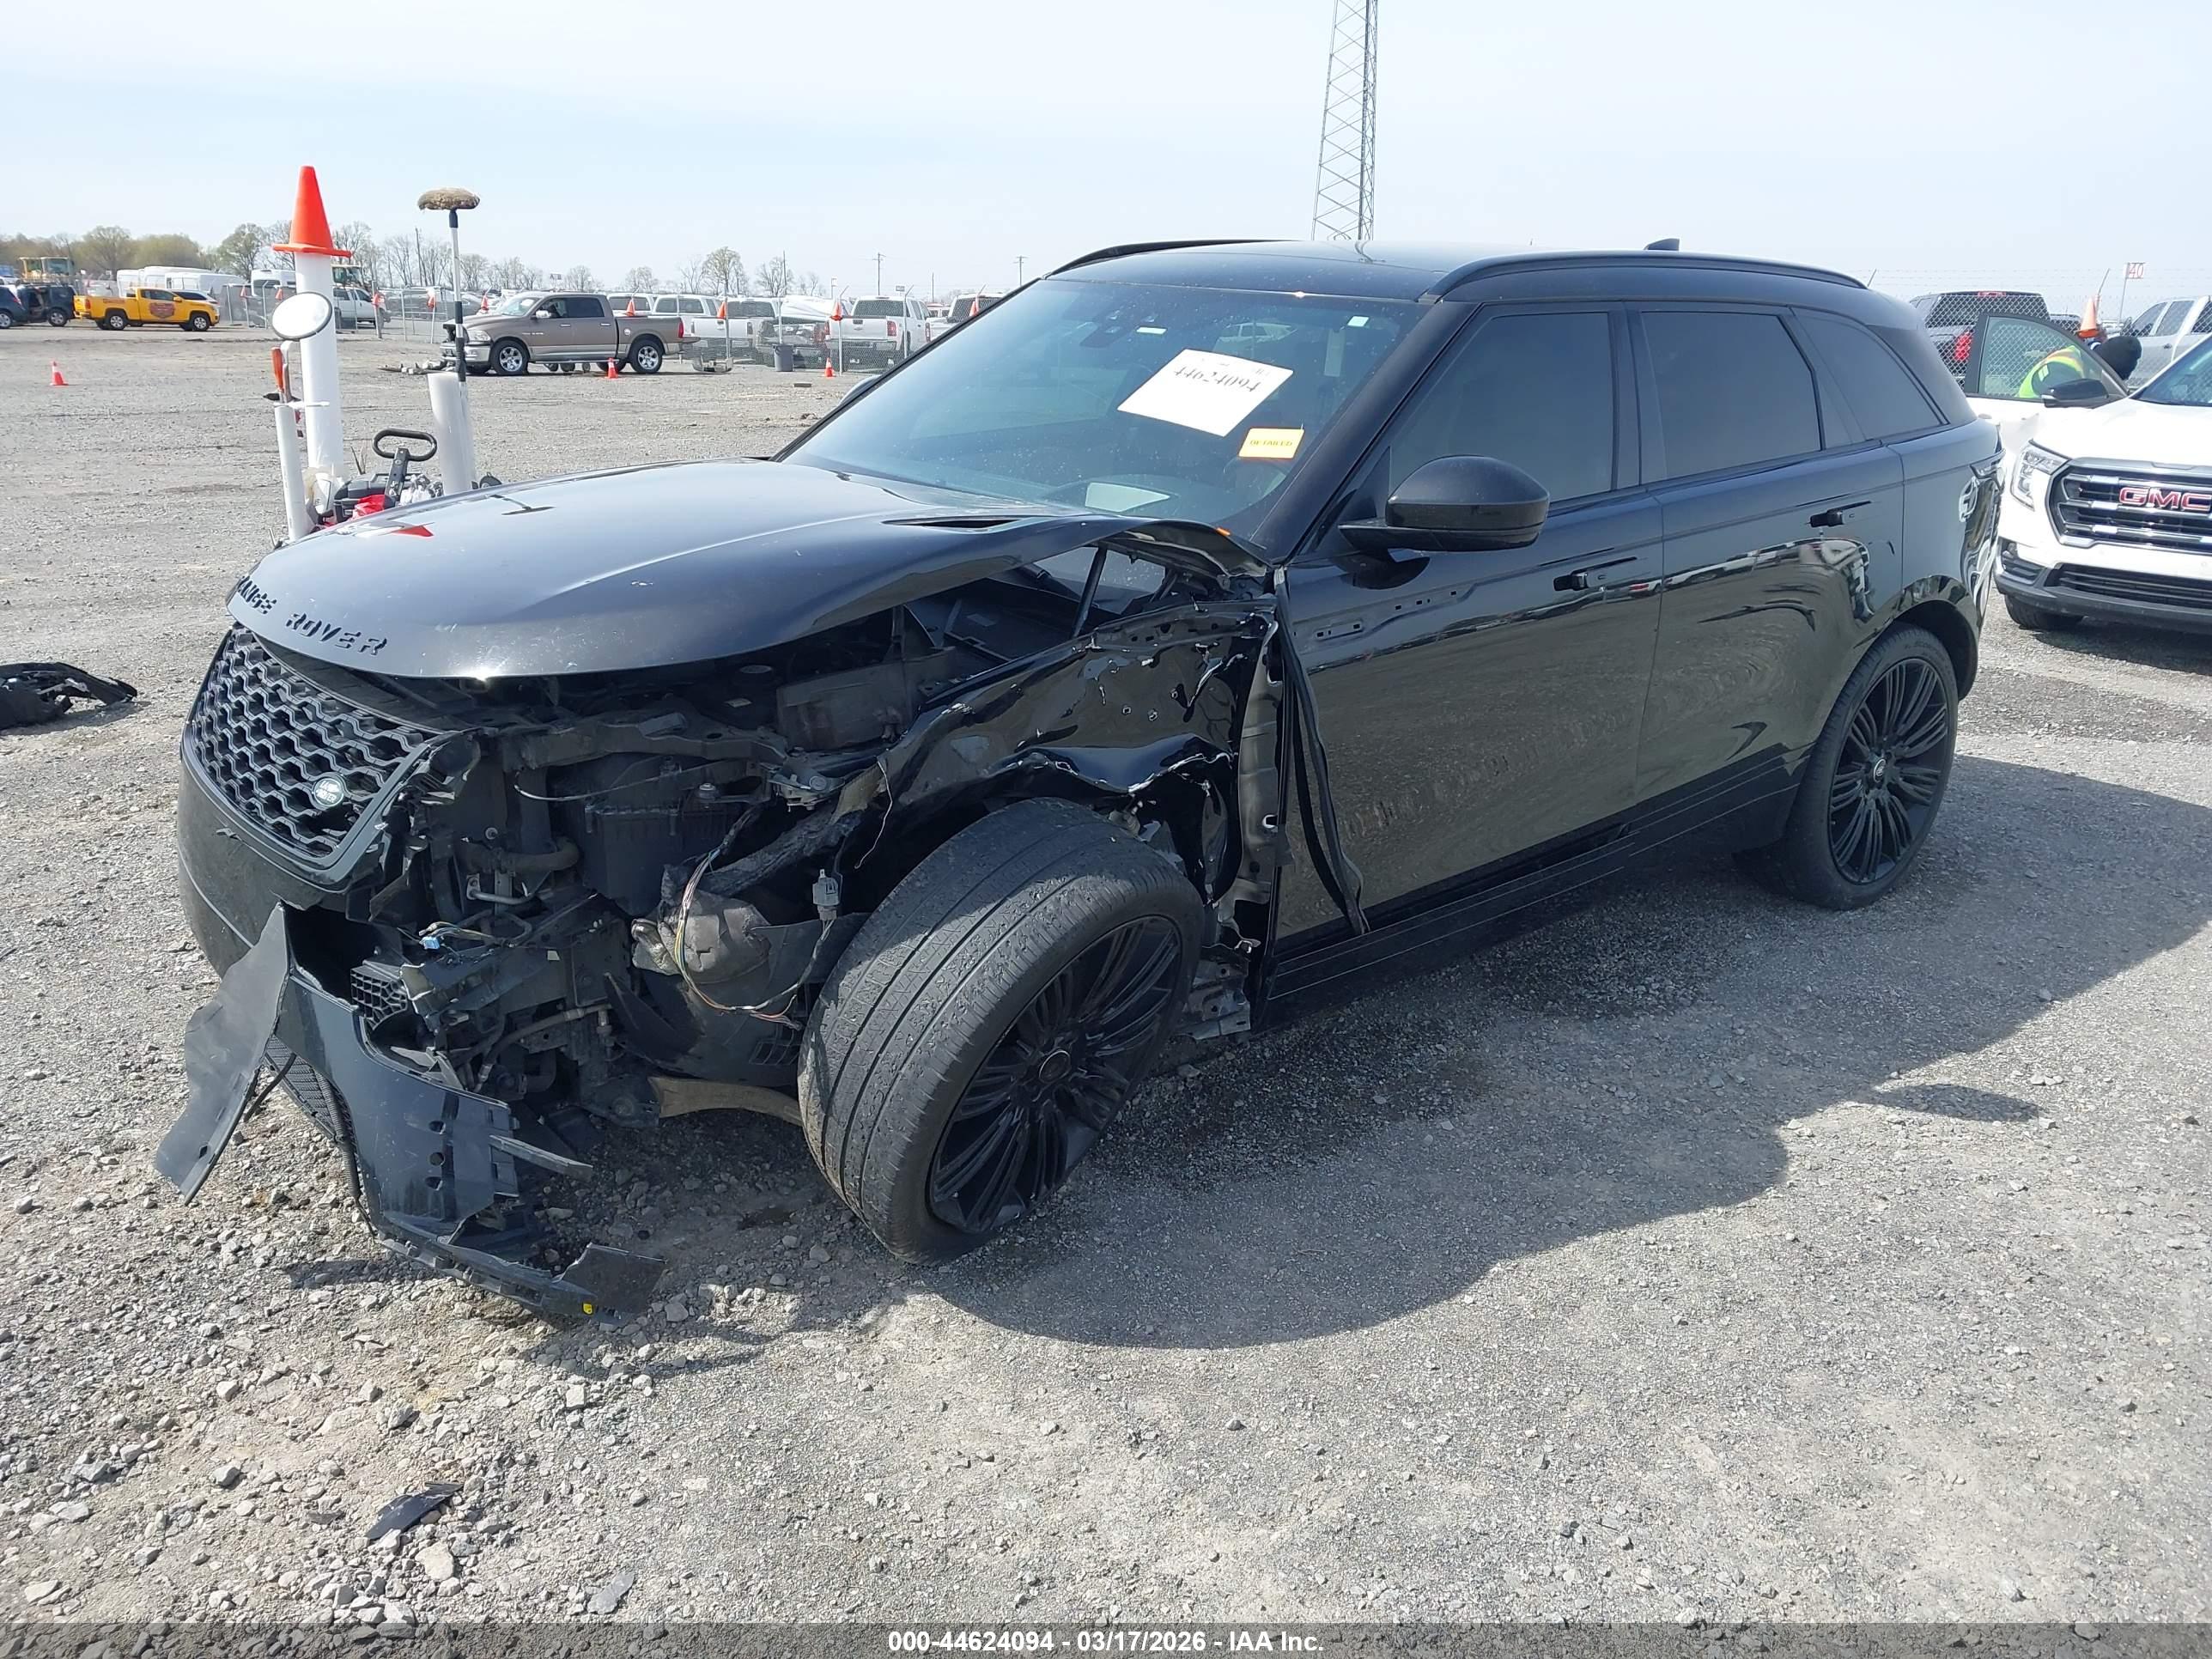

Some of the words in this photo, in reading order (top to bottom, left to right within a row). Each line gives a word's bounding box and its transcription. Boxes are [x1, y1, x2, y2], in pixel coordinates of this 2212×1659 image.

[2130, 263, 2144, 279] 40
[2119, 487, 2212, 512] GMC
[236, 575, 277, 615] ANGE
[285, 613, 387, 655] ROVER
